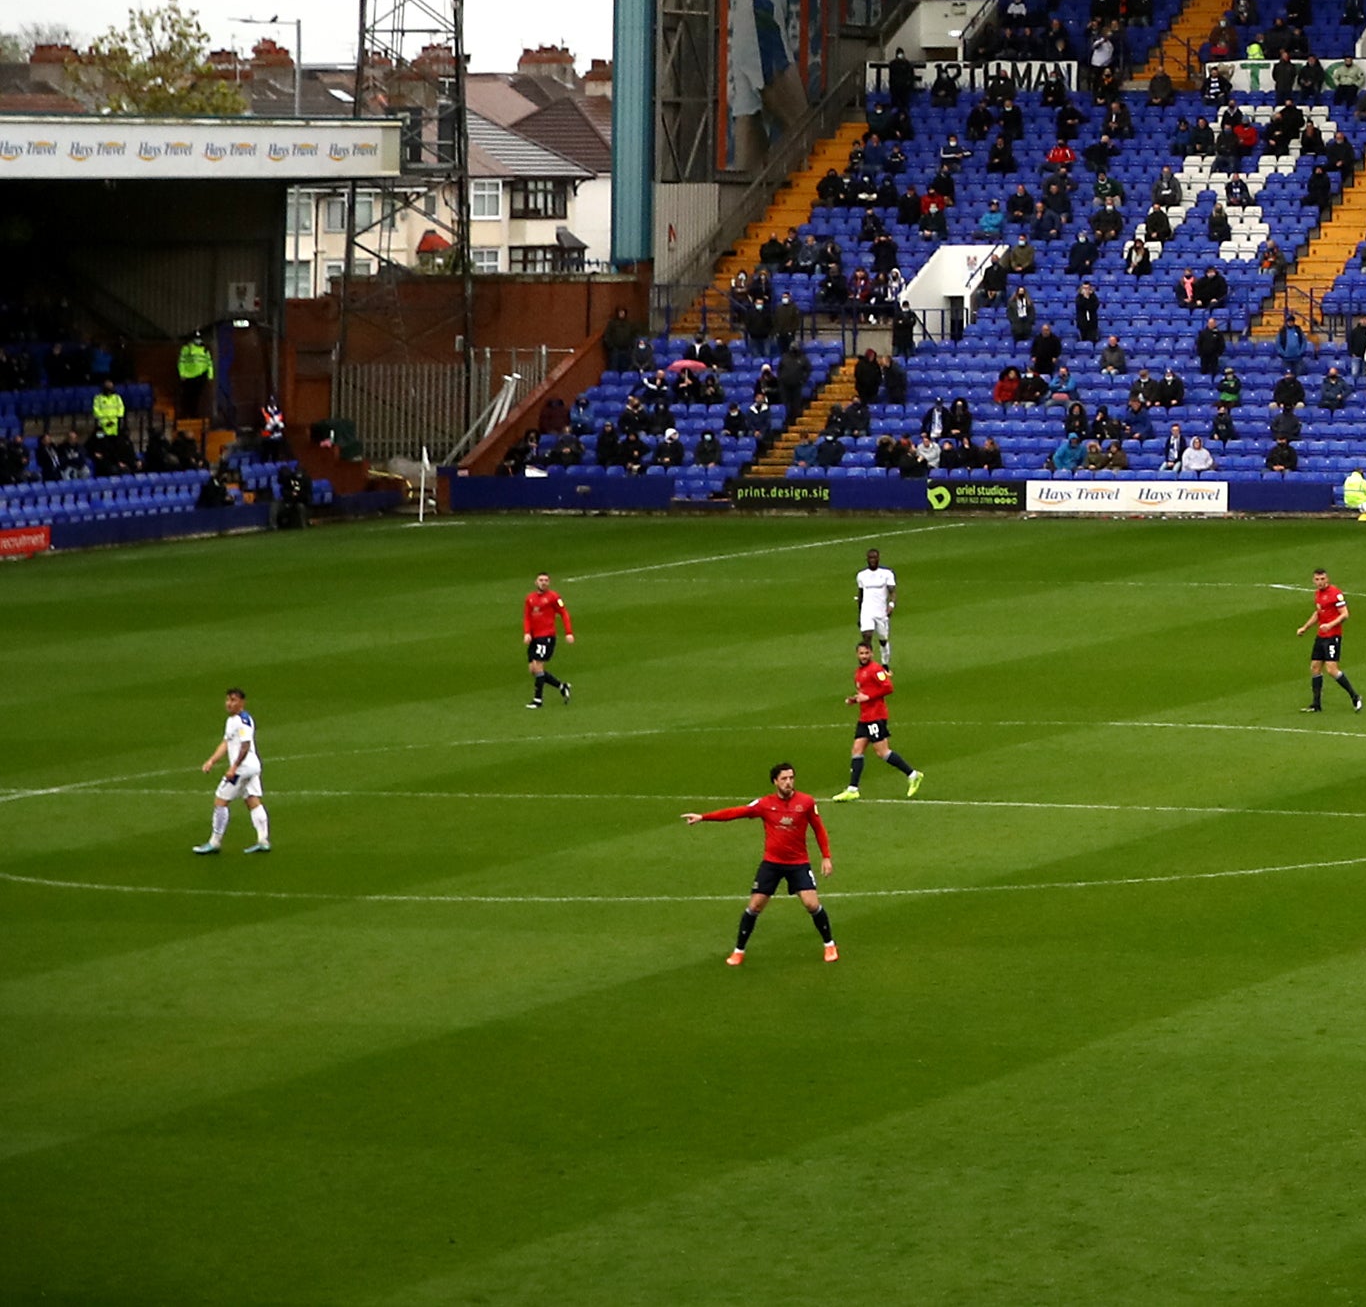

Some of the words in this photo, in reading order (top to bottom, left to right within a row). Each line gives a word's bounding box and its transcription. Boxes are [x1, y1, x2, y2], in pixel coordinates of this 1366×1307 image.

[1038, 488, 1073, 503] Hays
[1077, 488, 1120, 501] Travel
[1138, 488, 1173, 503] Hays
[1177, 489, 1221, 501] Travel
[1329, 645, 1335, 653] 5
[868, 723, 879, 735] 10
